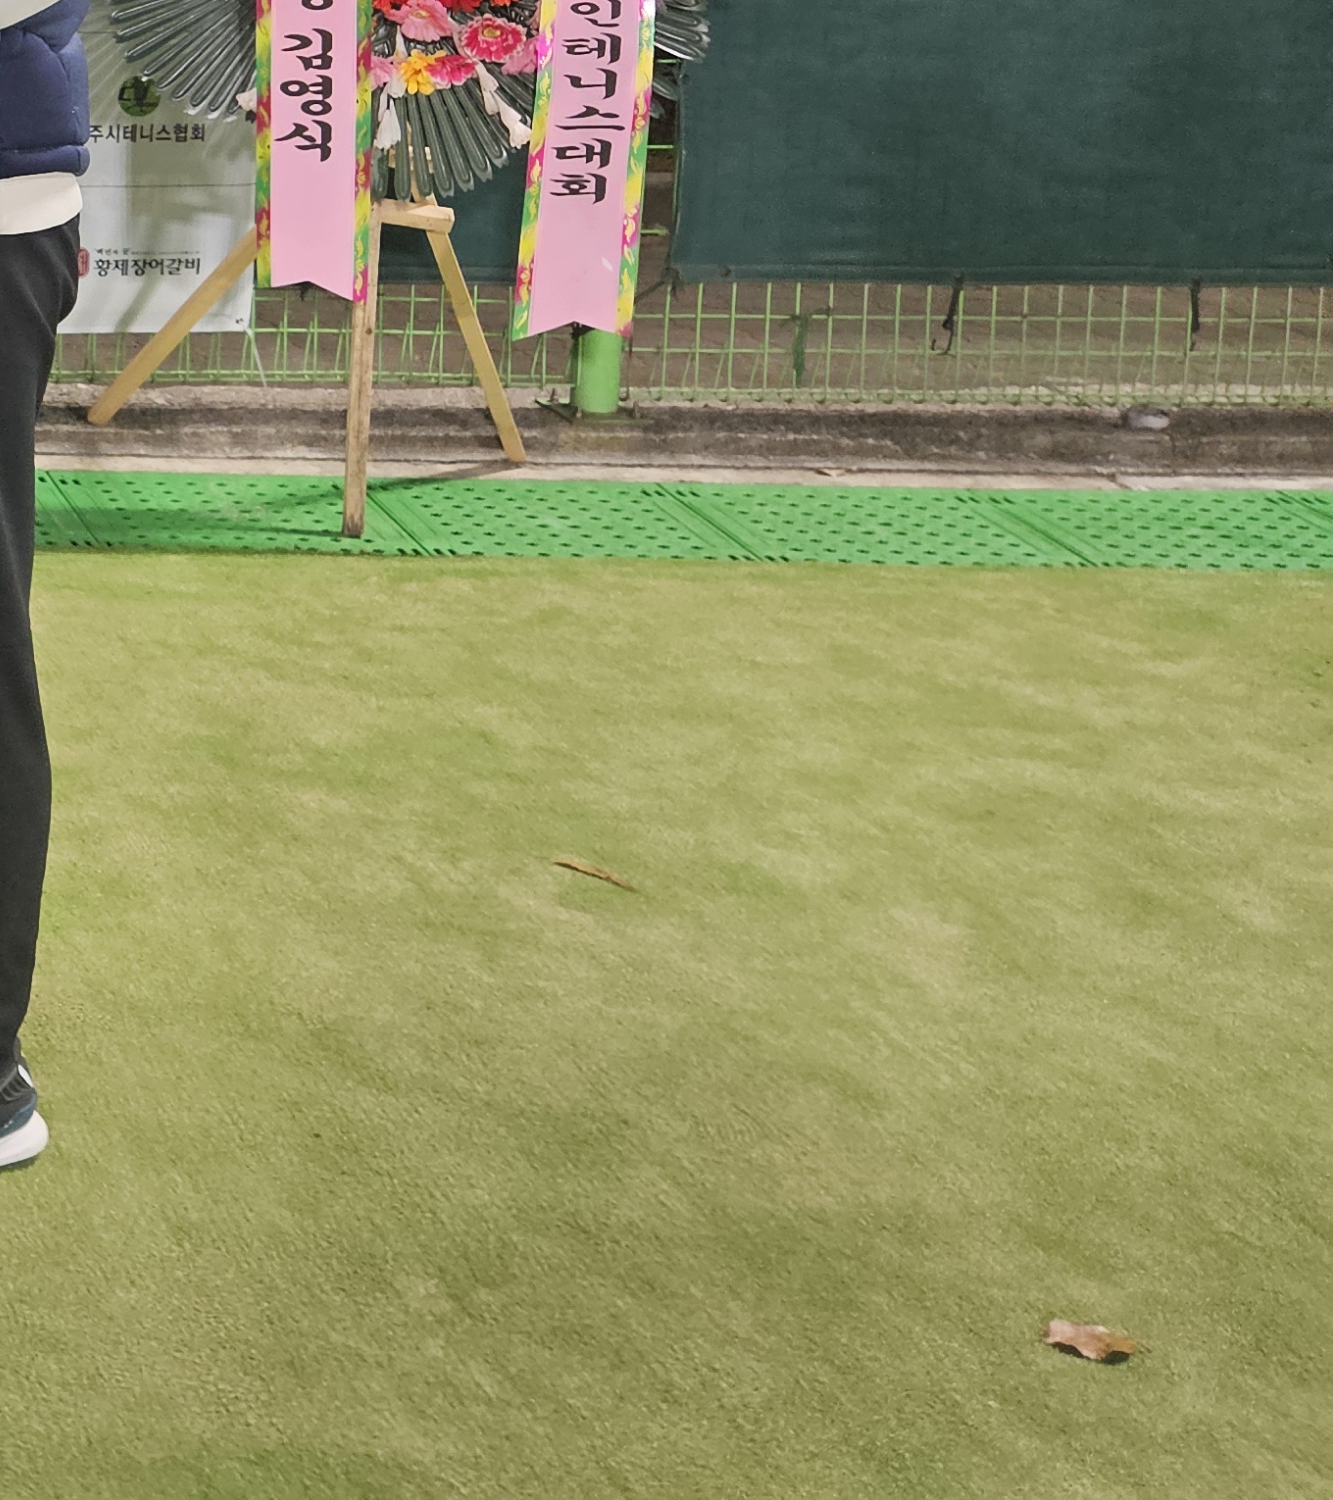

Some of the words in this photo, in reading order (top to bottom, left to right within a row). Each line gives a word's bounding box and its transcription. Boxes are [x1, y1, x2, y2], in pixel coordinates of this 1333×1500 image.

[274, 28, 335, 162] 김영식
[90, 123, 206, 143] 주시테니스협회
[94, 258, 201, 277] 황제장어갈비
